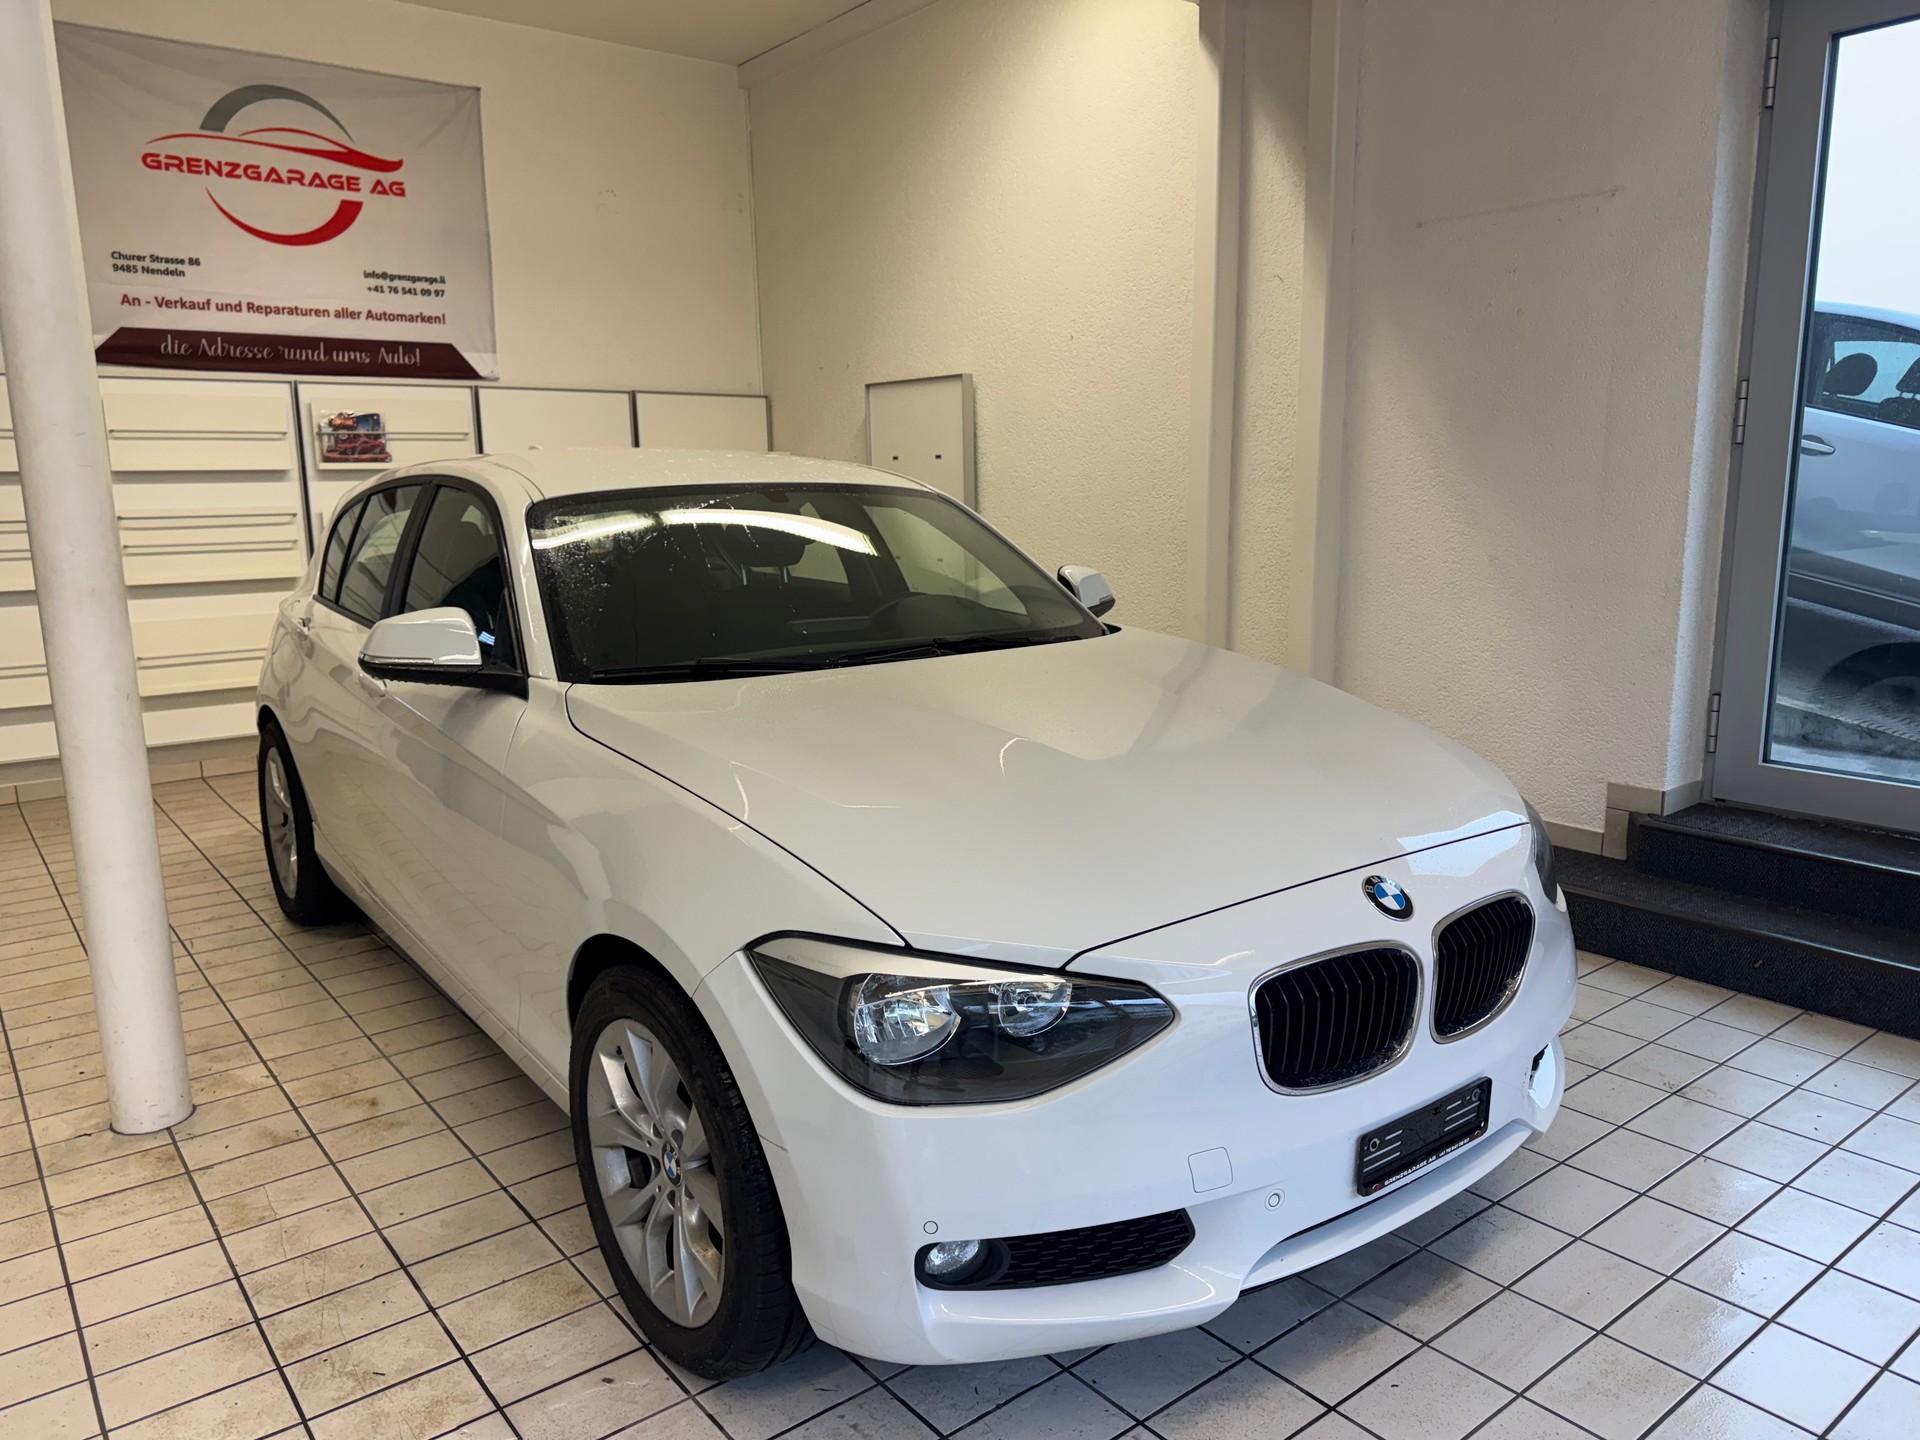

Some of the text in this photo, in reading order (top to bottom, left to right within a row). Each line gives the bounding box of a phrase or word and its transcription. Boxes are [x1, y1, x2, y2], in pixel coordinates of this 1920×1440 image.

[141, 152, 406, 197] GRENZGARAGE AG
[111, 251, 201, 266] Churer Strasse 86
[112, 263, 186, 277] 9485 Nendeln
[363, 270, 446, 285] info@grenzgarage.li
[367, 285, 445, 298] +41 76 541 09 97
[120, 294, 141, 307] An
[154, 295, 212, 311] Verkauf
[215, 301, 242, 313] und
[246, 302, 330, 317] Reparaturen
[334, 307, 362, 320] aller
[365, 309, 446, 325] Automarken!
[160, 334, 421, 367] die Adresse rund ums Auto!
